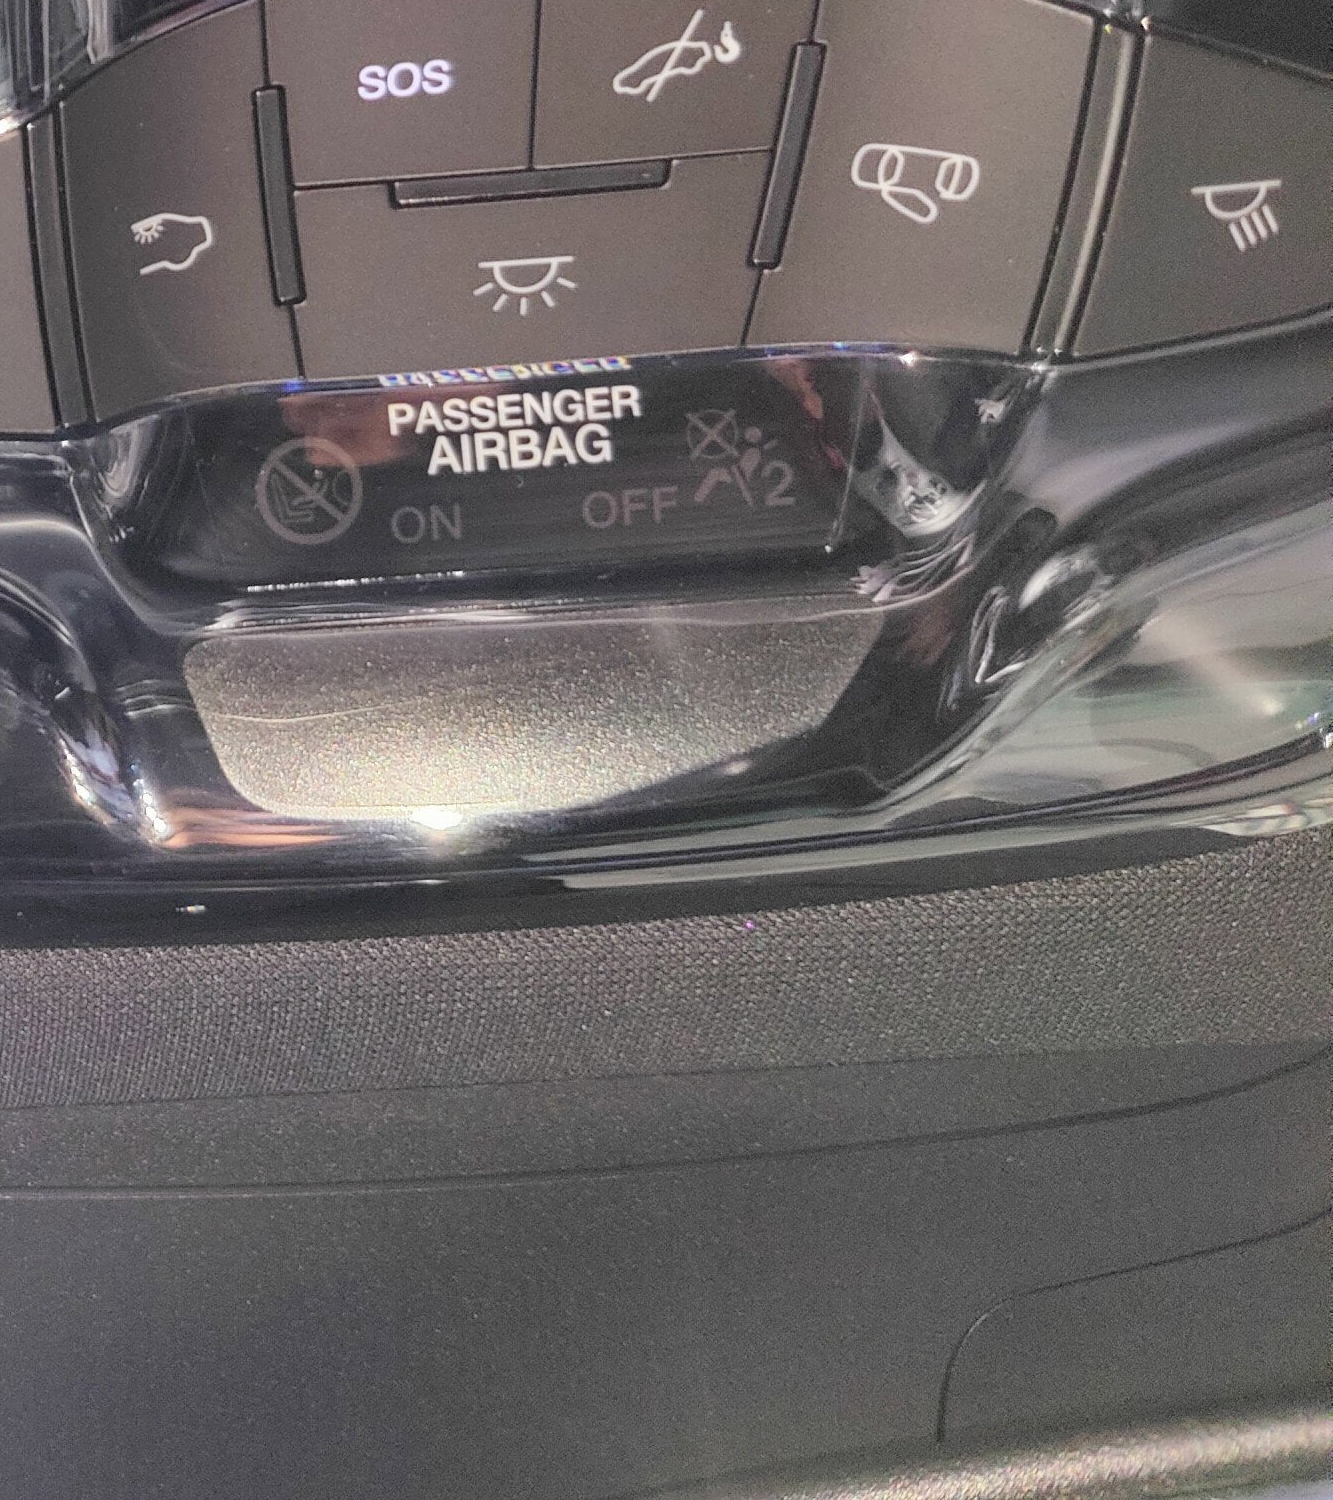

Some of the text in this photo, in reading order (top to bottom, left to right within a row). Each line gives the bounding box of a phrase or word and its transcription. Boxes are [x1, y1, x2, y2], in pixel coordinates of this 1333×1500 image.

[357, 59, 452, 100] SOS
[387, 385, 642, 436] PASSENGER
[427, 423, 613, 476] AIRBAG
[391, 503, 463, 544] ON
[584, 486, 679, 528] OFF
